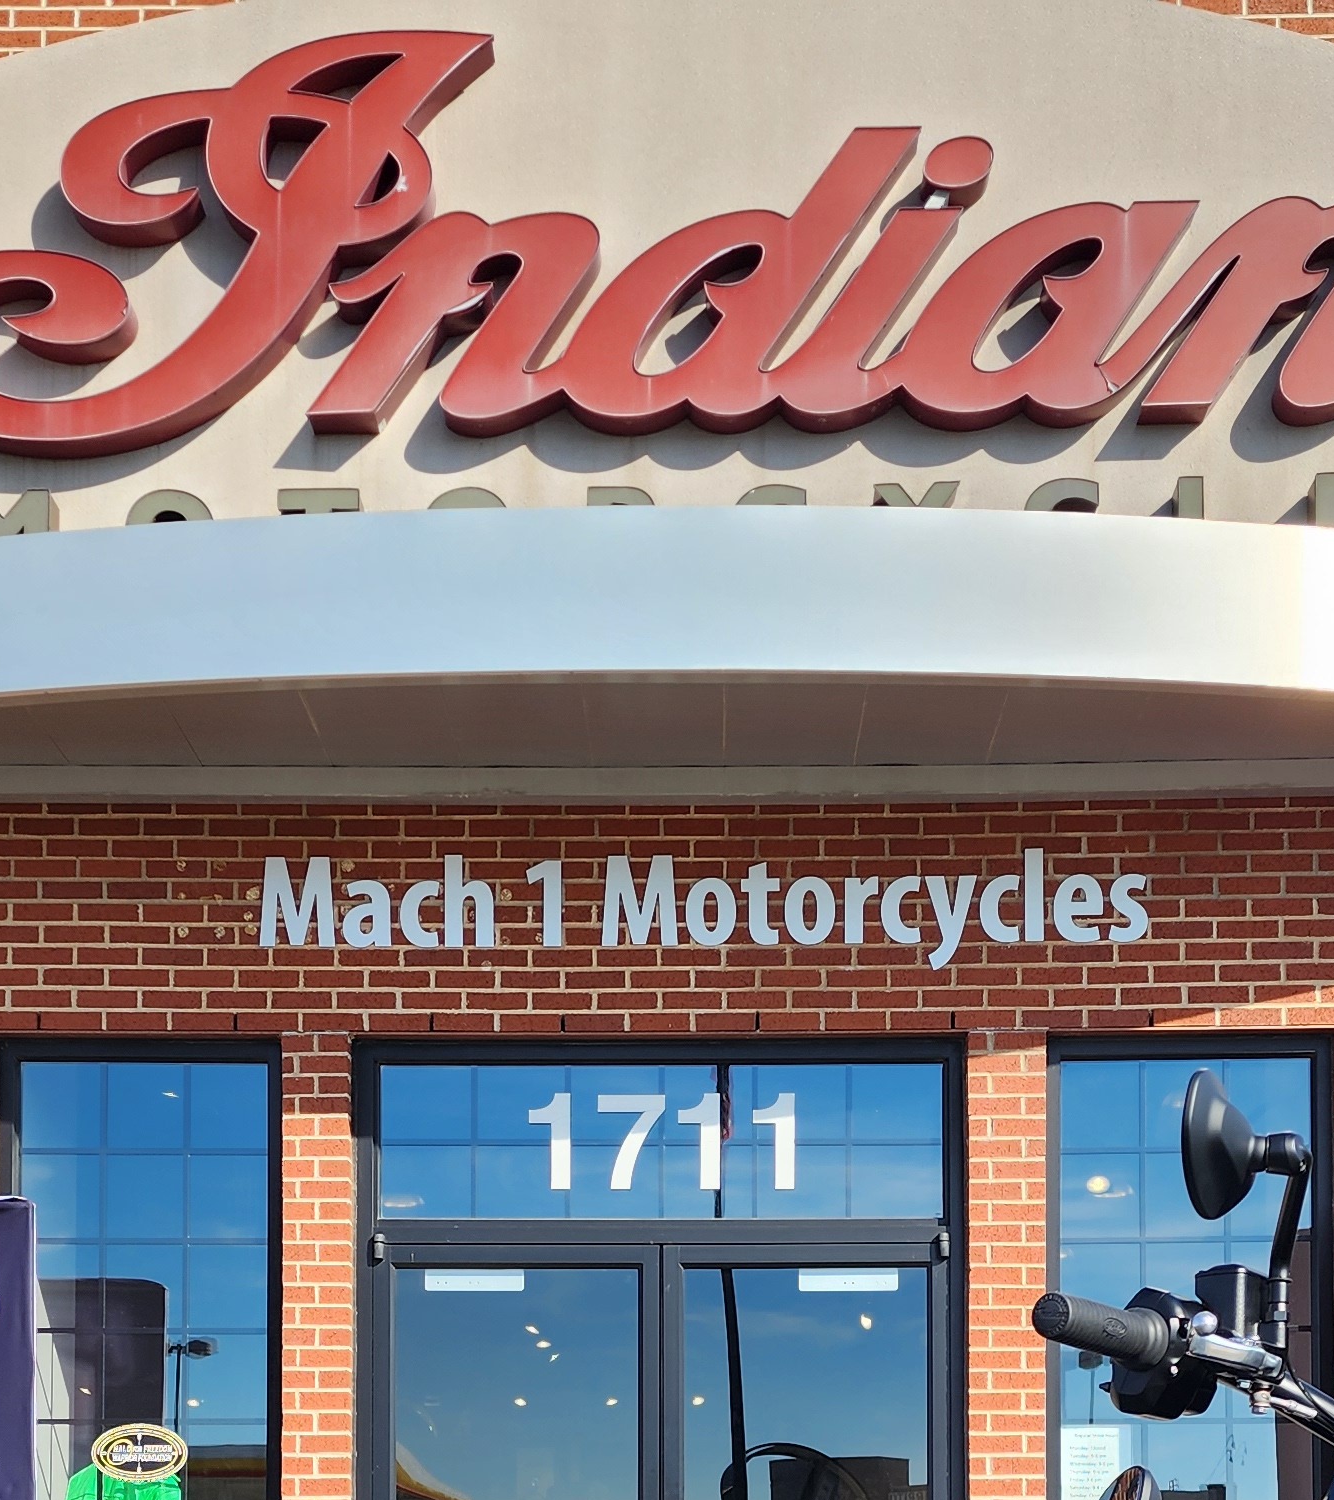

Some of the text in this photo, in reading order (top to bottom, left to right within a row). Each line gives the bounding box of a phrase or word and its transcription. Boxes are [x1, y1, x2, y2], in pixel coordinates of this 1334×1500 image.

[259, 848, 1149, 971] Mach 1 Motorcycles
[528, 1092, 796, 1191] 1711
